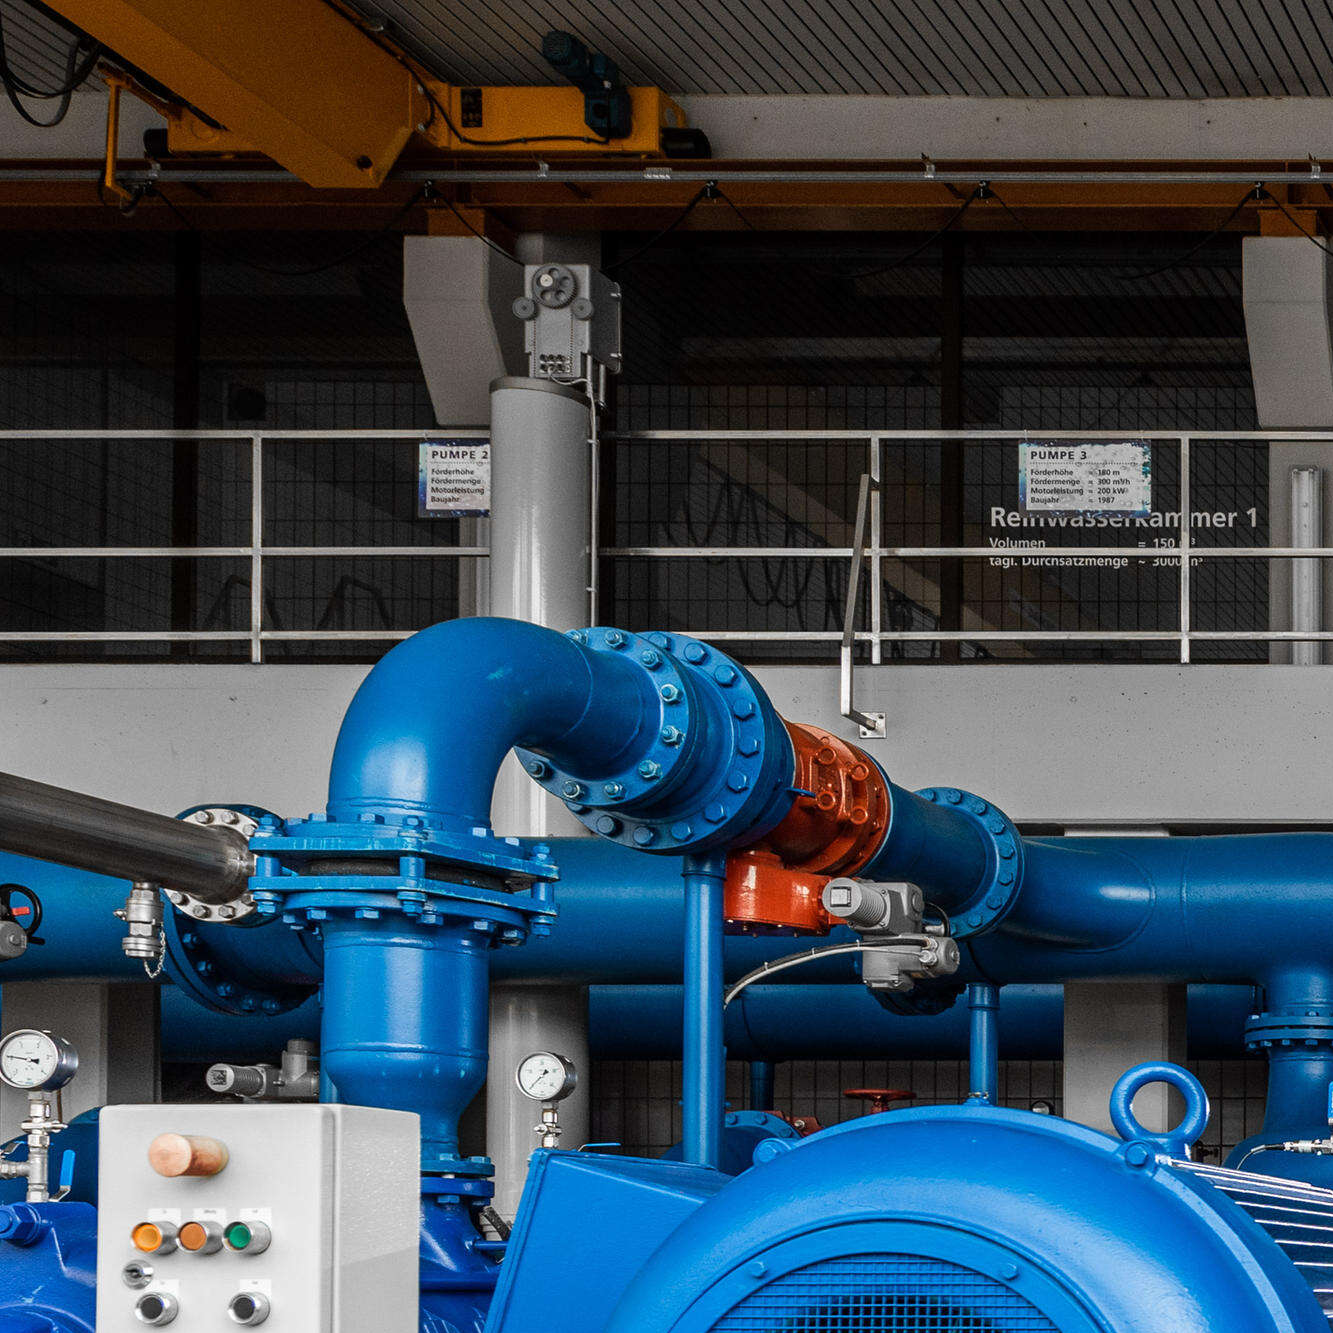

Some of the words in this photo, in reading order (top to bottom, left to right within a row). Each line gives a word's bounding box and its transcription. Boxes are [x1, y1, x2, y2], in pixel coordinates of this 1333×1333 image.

[432, 451, 476, 459] PUMPE
[482, 451, 488, 459] 2
[1031, 451, 1074, 460] PUMPE
[1080, 451, 1087, 460] 3
[431, 487, 484, 495] Motorleistung
[1247, 508, 1257, 527] 1
[990, 537, 1046, 548] Volumen
[1153, 538, 1174, 548] 150
[1023, 558, 1128, 568] Durchsatzmenge
[1153, 558, 1181, 566] 3000
